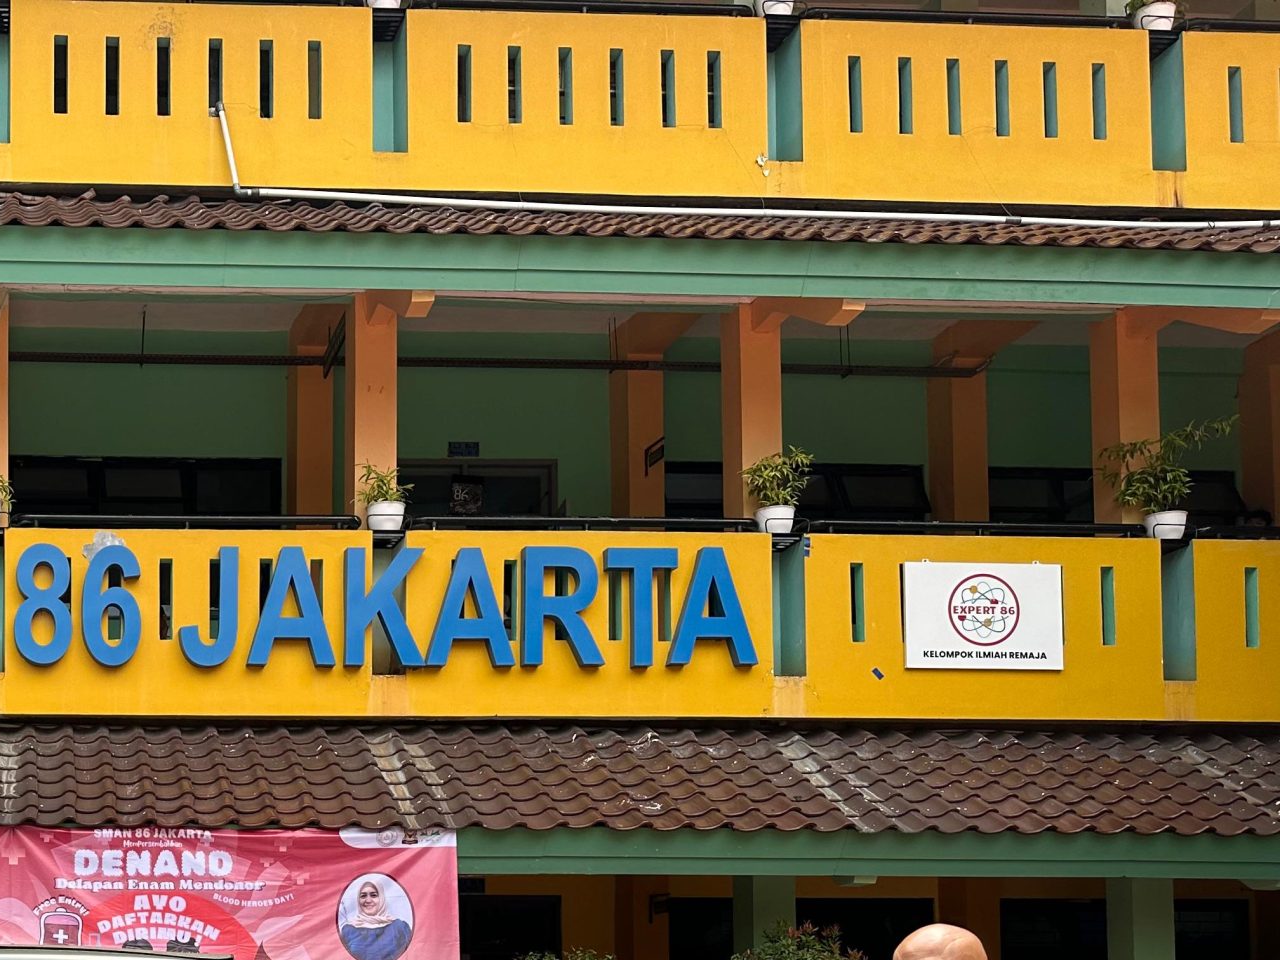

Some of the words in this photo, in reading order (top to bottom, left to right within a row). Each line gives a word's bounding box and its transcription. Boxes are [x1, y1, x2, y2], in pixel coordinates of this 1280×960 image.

[13, 543, 142, 668] 86
[177, 545, 760, 669] JAKARTA
[953, 605, 996, 615] EXPERT
[1000, 606, 1015, 616] 86
[923, 650, 974, 659] KELOMPOK
[975, 650, 1007, 659] ILMIAH
[1009, 651, 1047, 660] REMAJA
[93, 828, 132, 838] SMAN
[135, 828, 151, 838] 86
[153, 828, 212, 839] JAKARTA
[74, 849, 233, 877] DENAND
[54, 878, 124, 892] Delapan
[127, 879, 175, 890] Enam
[179, 878, 266, 891] Mendonor
[33, 896, 57, 916] Free
[58, 895, 90, 917] Entry!
[133, 894, 187, 913] AYO
[213, 893, 240, 906] BLOOD
[241, 899, 274, 907] HEROES
[274, 893, 295, 905] DAY!
[97, 911, 221, 941] DAFTARKAN
